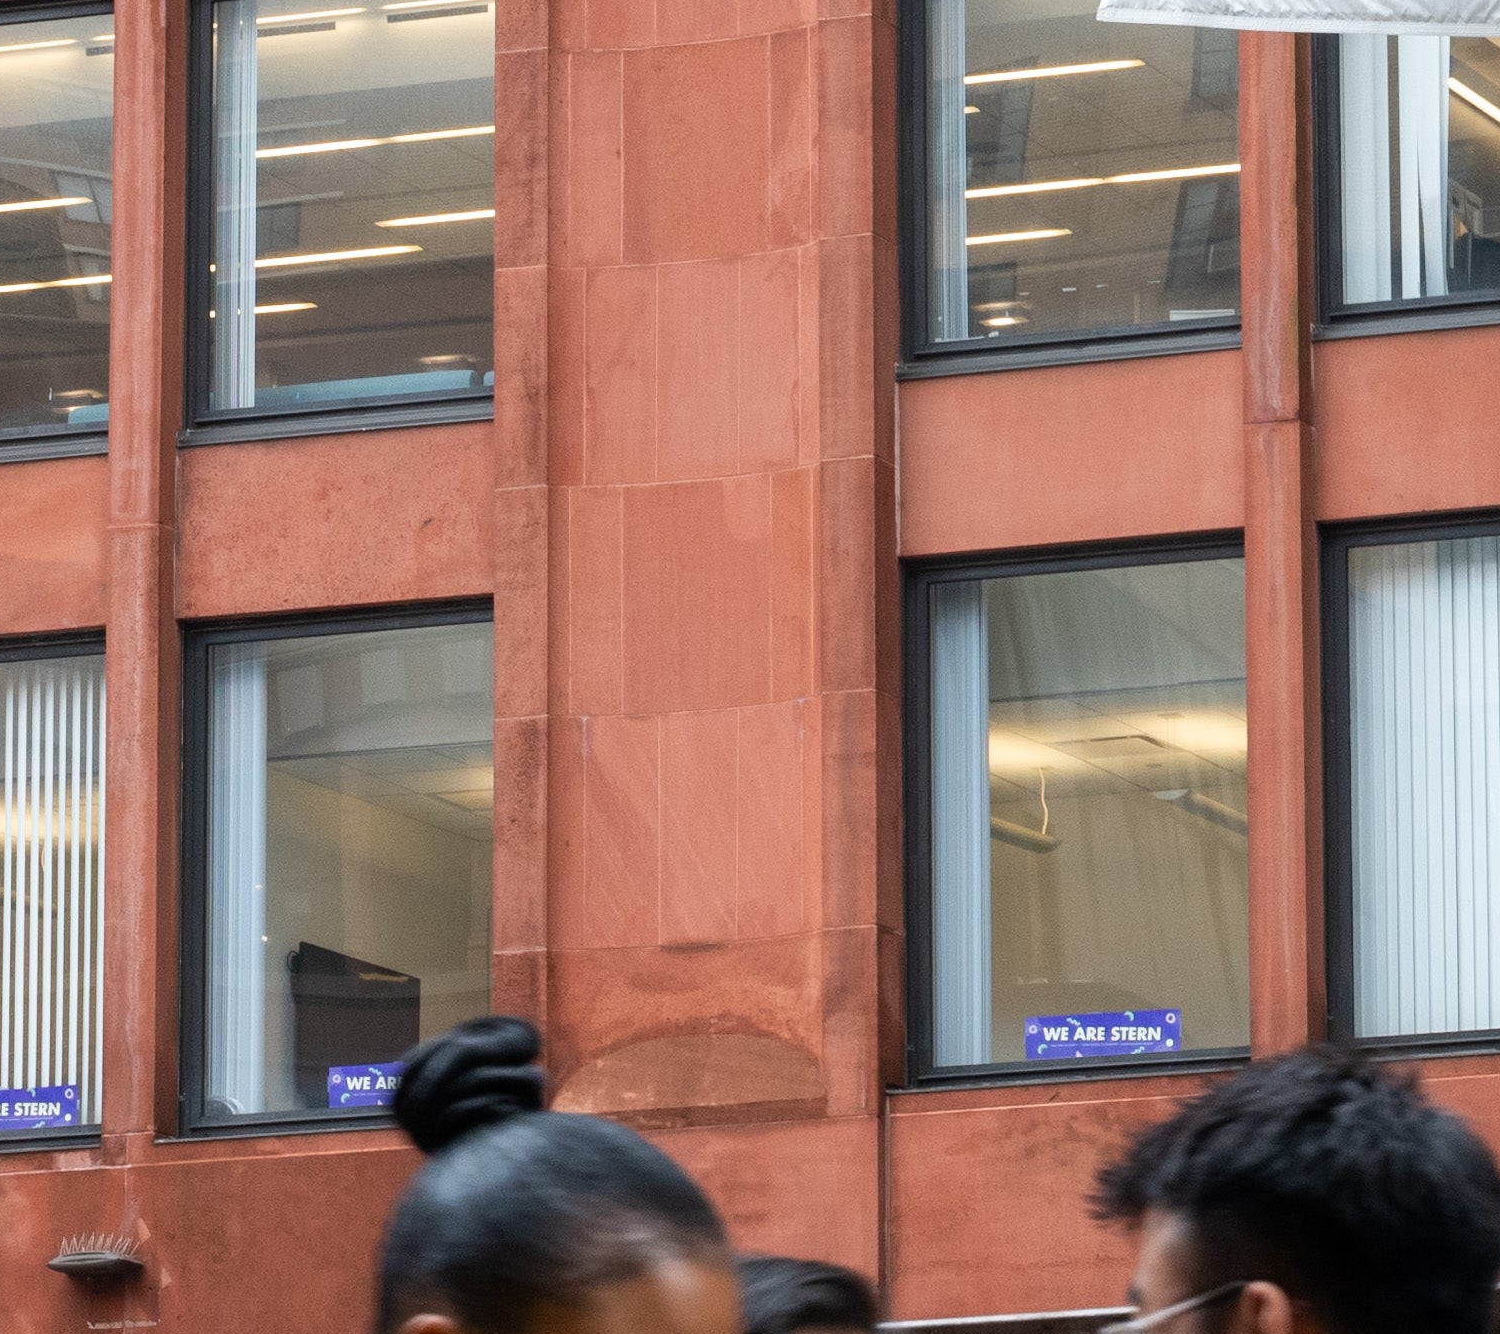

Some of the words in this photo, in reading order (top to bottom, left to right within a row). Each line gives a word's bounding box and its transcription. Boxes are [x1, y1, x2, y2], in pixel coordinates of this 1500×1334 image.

[1043, 1027, 1069, 1041] WE
[1073, 1026, 1106, 1041] ARE
[1110, 1026, 1162, 1041] STERN
[346, 1076, 371, 1090] WE
[13, 1102, 61, 1116] STERN
